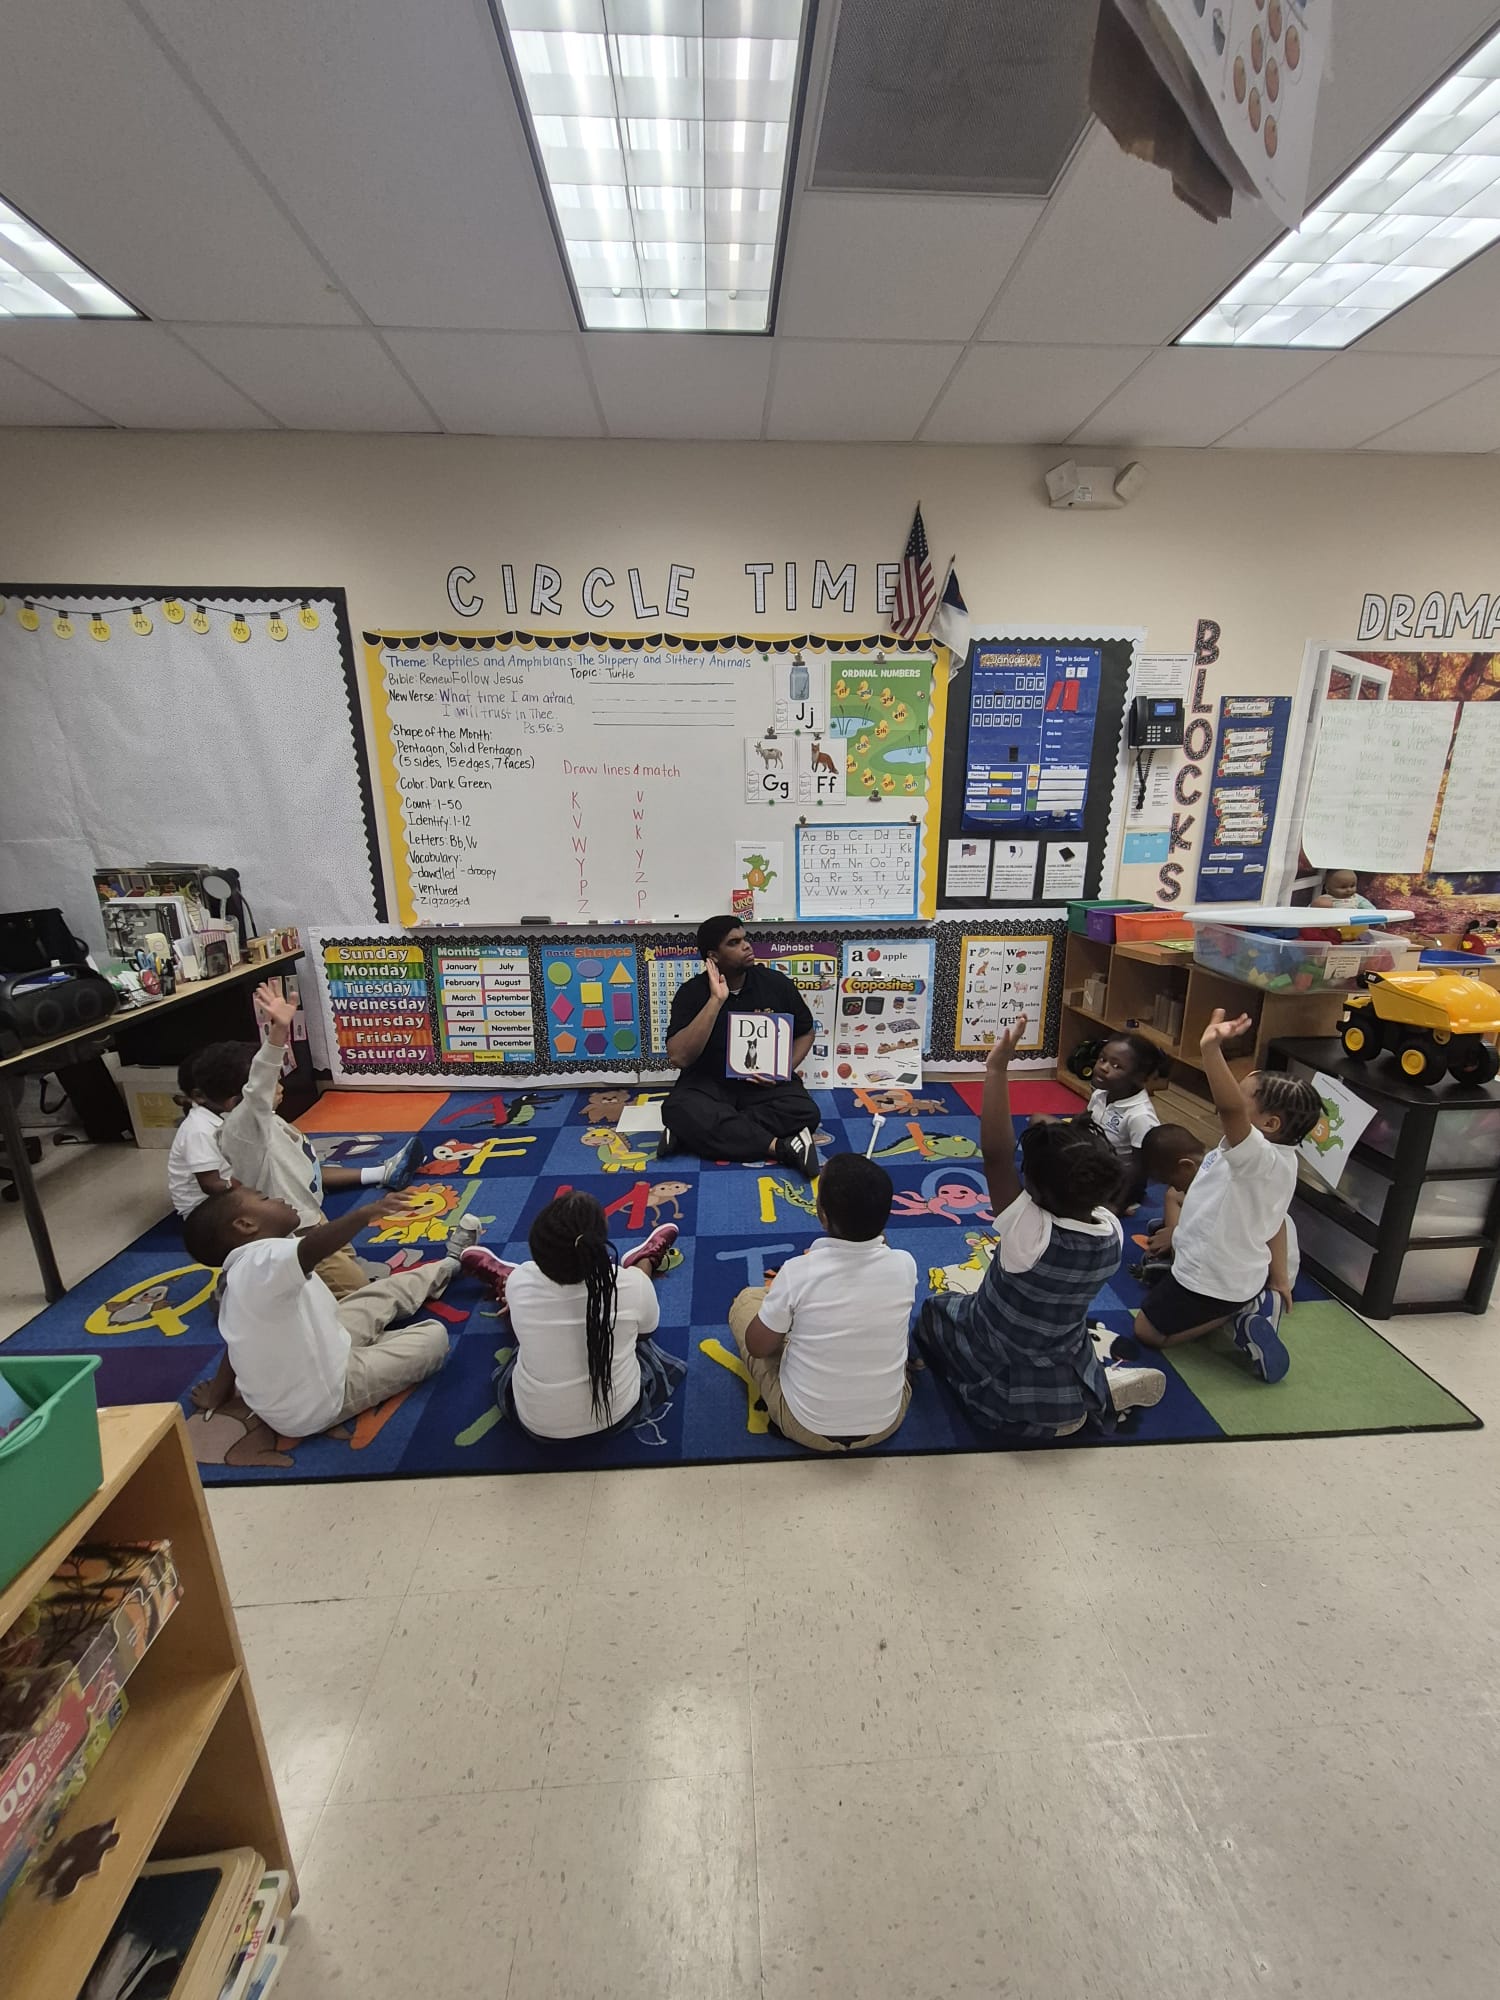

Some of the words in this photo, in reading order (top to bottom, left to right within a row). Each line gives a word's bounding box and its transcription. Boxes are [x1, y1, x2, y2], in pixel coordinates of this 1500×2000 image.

[446, 563, 695, 619] CIRCLE
[745, 560, 900, 614] TIME
[433, 652, 479, 669] Reptiles
[484, 656, 505, 668] and
[577, 654, 595, 666] The
[598, 654, 638, 670] Slippery
[643, 653, 661, 665] and
[665, 654, 705, 668] Slithery
[709, 655, 751, 669] Animals
[493, 672, 524, 685] Jesus
[605, 667, 634, 679] Turtle
[841, 668, 878, 679] ORDINAL
[880, 668, 921, 679] NUMBERS
[389, 689, 408, 702] New
[439, 688, 471, 704] What
[478, 690, 505, 704] time
[511, 690, 518, 703] I
[521, 693, 539, 703] am
[456, 704, 479, 719] will
[796, 702, 814, 729] Jj
[394, 724, 422, 739] Shape
[425, 726, 436, 737] of
[437, 726, 456, 739] the
[450, 742, 475, 754] Solid
[478, 742, 522, 758] Pentagon
[1156, 618, 1222, 903] BLOCKS
[563, 760, 598, 775] Draw
[603, 762, 630, 776] lines
[643, 764, 680, 778] match
[430, 776, 455, 789] Dark
[458, 776, 492, 790] Green
[762, 773, 789, 799] Gg
[817, 776, 837, 793] Ff
[571, 791, 581, 810] K
[572, 813, 582, 829] V
[801, 831, 816, 841] Aa
[825, 830, 839, 841] Bb
[849, 830, 863, 841] Cc
[874, 829, 889, 840] Dd
[899, 829, 912, 840] Ee
[571, 836, 587, 853] W
[819, 844, 836, 859] Gg
[900, 843, 912, 854] Kk
[575, 858, 585, 877] Y
[870, 858, 886, 868] Oo
[830, 872, 843, 882] Rr
[826, 886, 847, 896] Ww
[896, 884, 911, 895] Zz
[733, 897, 753, 910] UNO
[339, 948, 409, 961] Sunday
[437, 947, 480, 957] Months
[497, 947, 523, 957] Year
[574, 947, 632, 959] Shapes
[655, 945, 699, 958] Numbers
[770, 943, 814, 955] Alphabet
[851, 949, 864, 962] a
[882, 953, 908, 963] apple
[343, 964, 408, 980] Monday
[445, 963, 477, 971] January
[499, 963, 514, 971] July
[968, 963, 975, 974] f
[1005, 964, 1014, 974] y
[344, 982, 411, 996] Tuesday
[445, 979, 479, 987] February
[494, 979, 521, 987] August
[851, 979, 915, 993] opposites
[1003, 982, 1012, 992] p
[486, 994, 529, 1002] September
[966, 999, 974, 1009] k
[334, 999, 426, 1012] Wednesday
[456, 1010, 475, 1018] April
[494, 1009, 526, 1017] October
[340, 1015, 425, 1029] Thursday
[458, 1025, 475, 1033] May
[737, 1020, 768, 1038] Dd
[356, 1032, 414, 1045] Friday
[459, 1040, 478, 1048] June
[346, 1048, 427, 1060] Saturday
[17, 1764, 52, 1819] Safari
